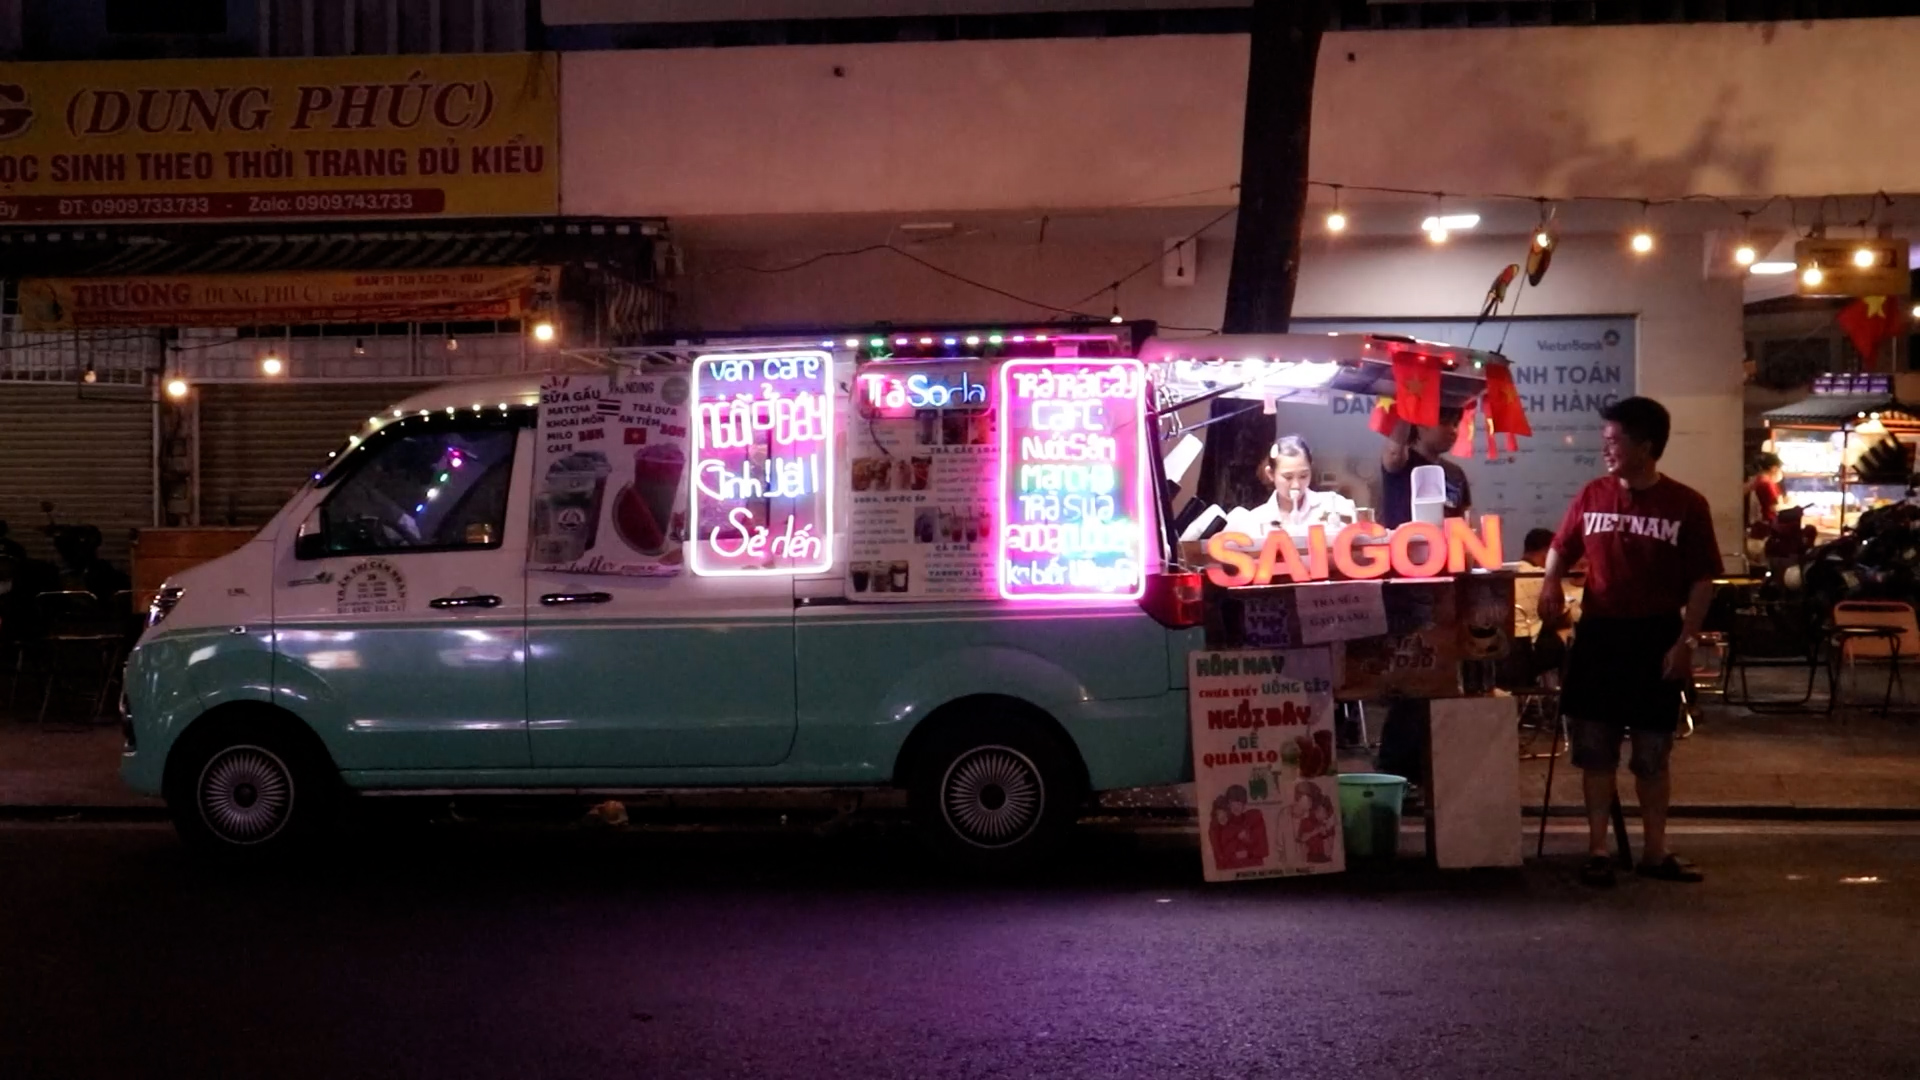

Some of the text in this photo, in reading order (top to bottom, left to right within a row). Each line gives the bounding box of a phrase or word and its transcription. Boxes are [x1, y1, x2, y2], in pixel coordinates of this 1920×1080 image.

[66, 87, 272, 137] (DUNG
[290, 70, 494, 129] PHÚC)
[51, 153, 125, 182] SINH
[136, 152, 213, 180] THEO
[224, 144, 293, 179] THỜI
[304, 148, 407, 177] TRANG
[418, 137, 460, 175] ĐỦ
[472, 134, 544, 174] KIỂU
[57, 198, 89, 216] ĐT:
[91, 196, 210, 215] 0909.733.733
[248, 196, 293, 213] Zalo:
[295, 193, 414, 211] 0909.743.733
[1555, 362, 1621, 384] TOÁN
[1583, 512, 1682, 546] VIETNAM
[1205, 514, 1503, 587] SAIGON
